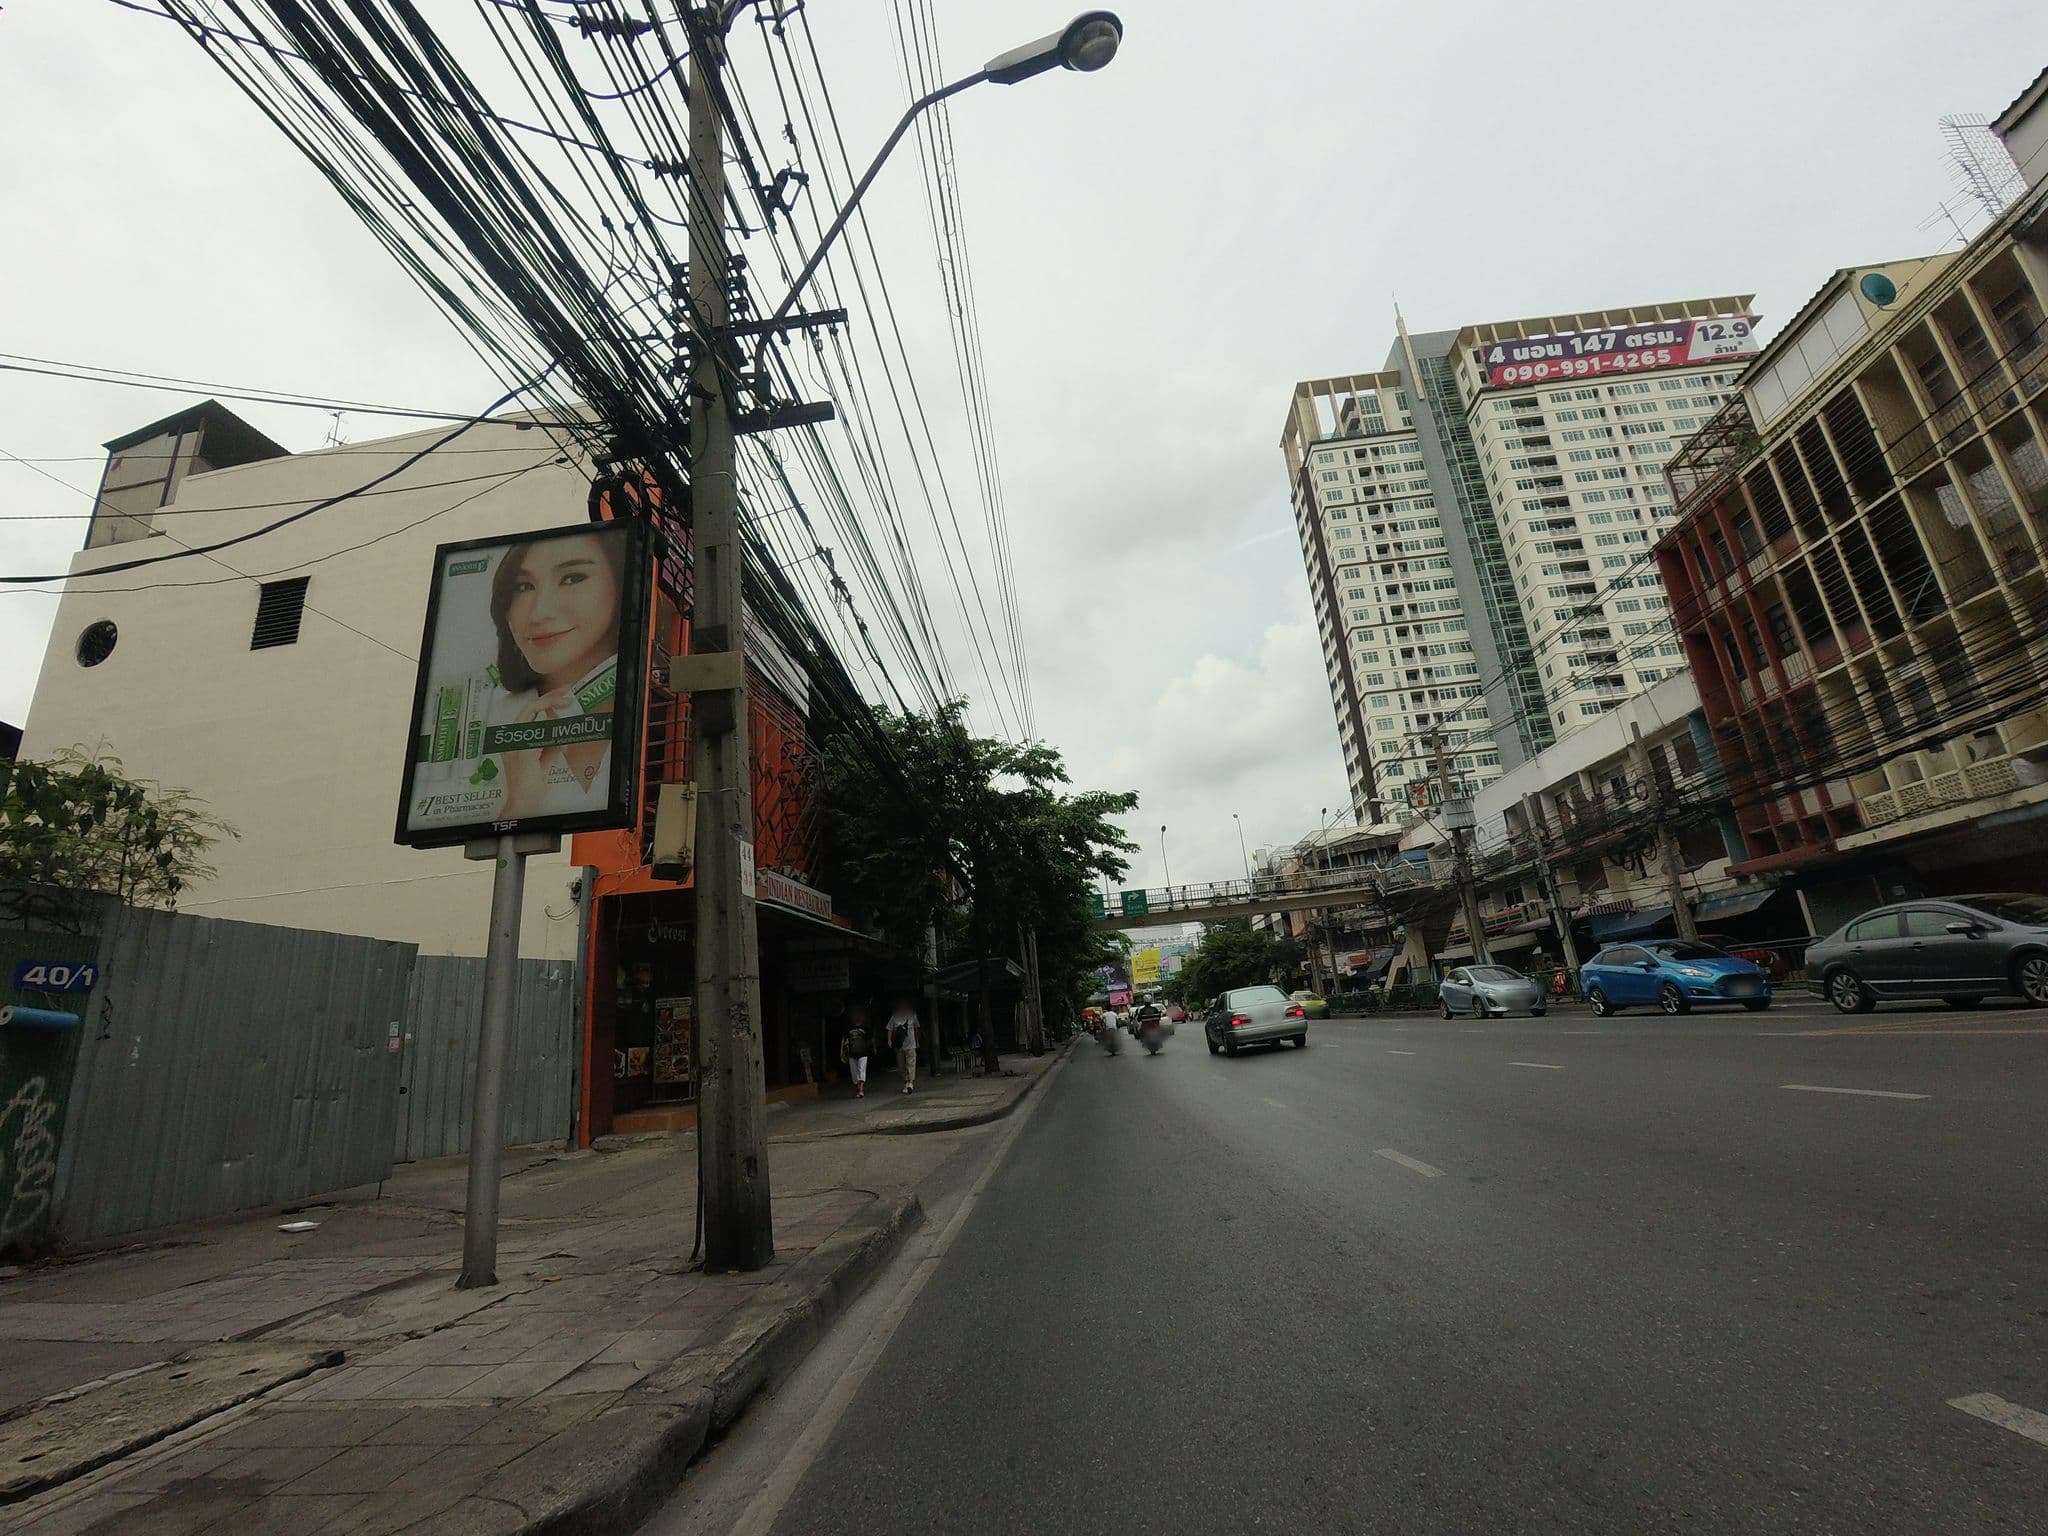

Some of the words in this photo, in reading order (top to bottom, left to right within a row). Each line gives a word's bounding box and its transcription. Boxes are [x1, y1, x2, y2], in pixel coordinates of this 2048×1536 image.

[1697, 321, 1749, 342] 12.9
[1488, 346, 1506, 364] 4
[1512, 342, 1563, 361] นอน
[1569, 333, 1616, 355] 147
[1625, 330, 1683, 348] ตรม.
[1502, 349, 1672, 382] 090-991-4265
[494, 724, 545, 745] ริ้วรอย
[435, 793, 462, 805] BEST
[463, 788, 502, 803] SELLER
[492, 820, 518, 832] TSF
[768, 876, 795, 905] INDIAN
[794, 888, 832, 920] RESTAURANT
[22, 964, 94, 990] 40/1
